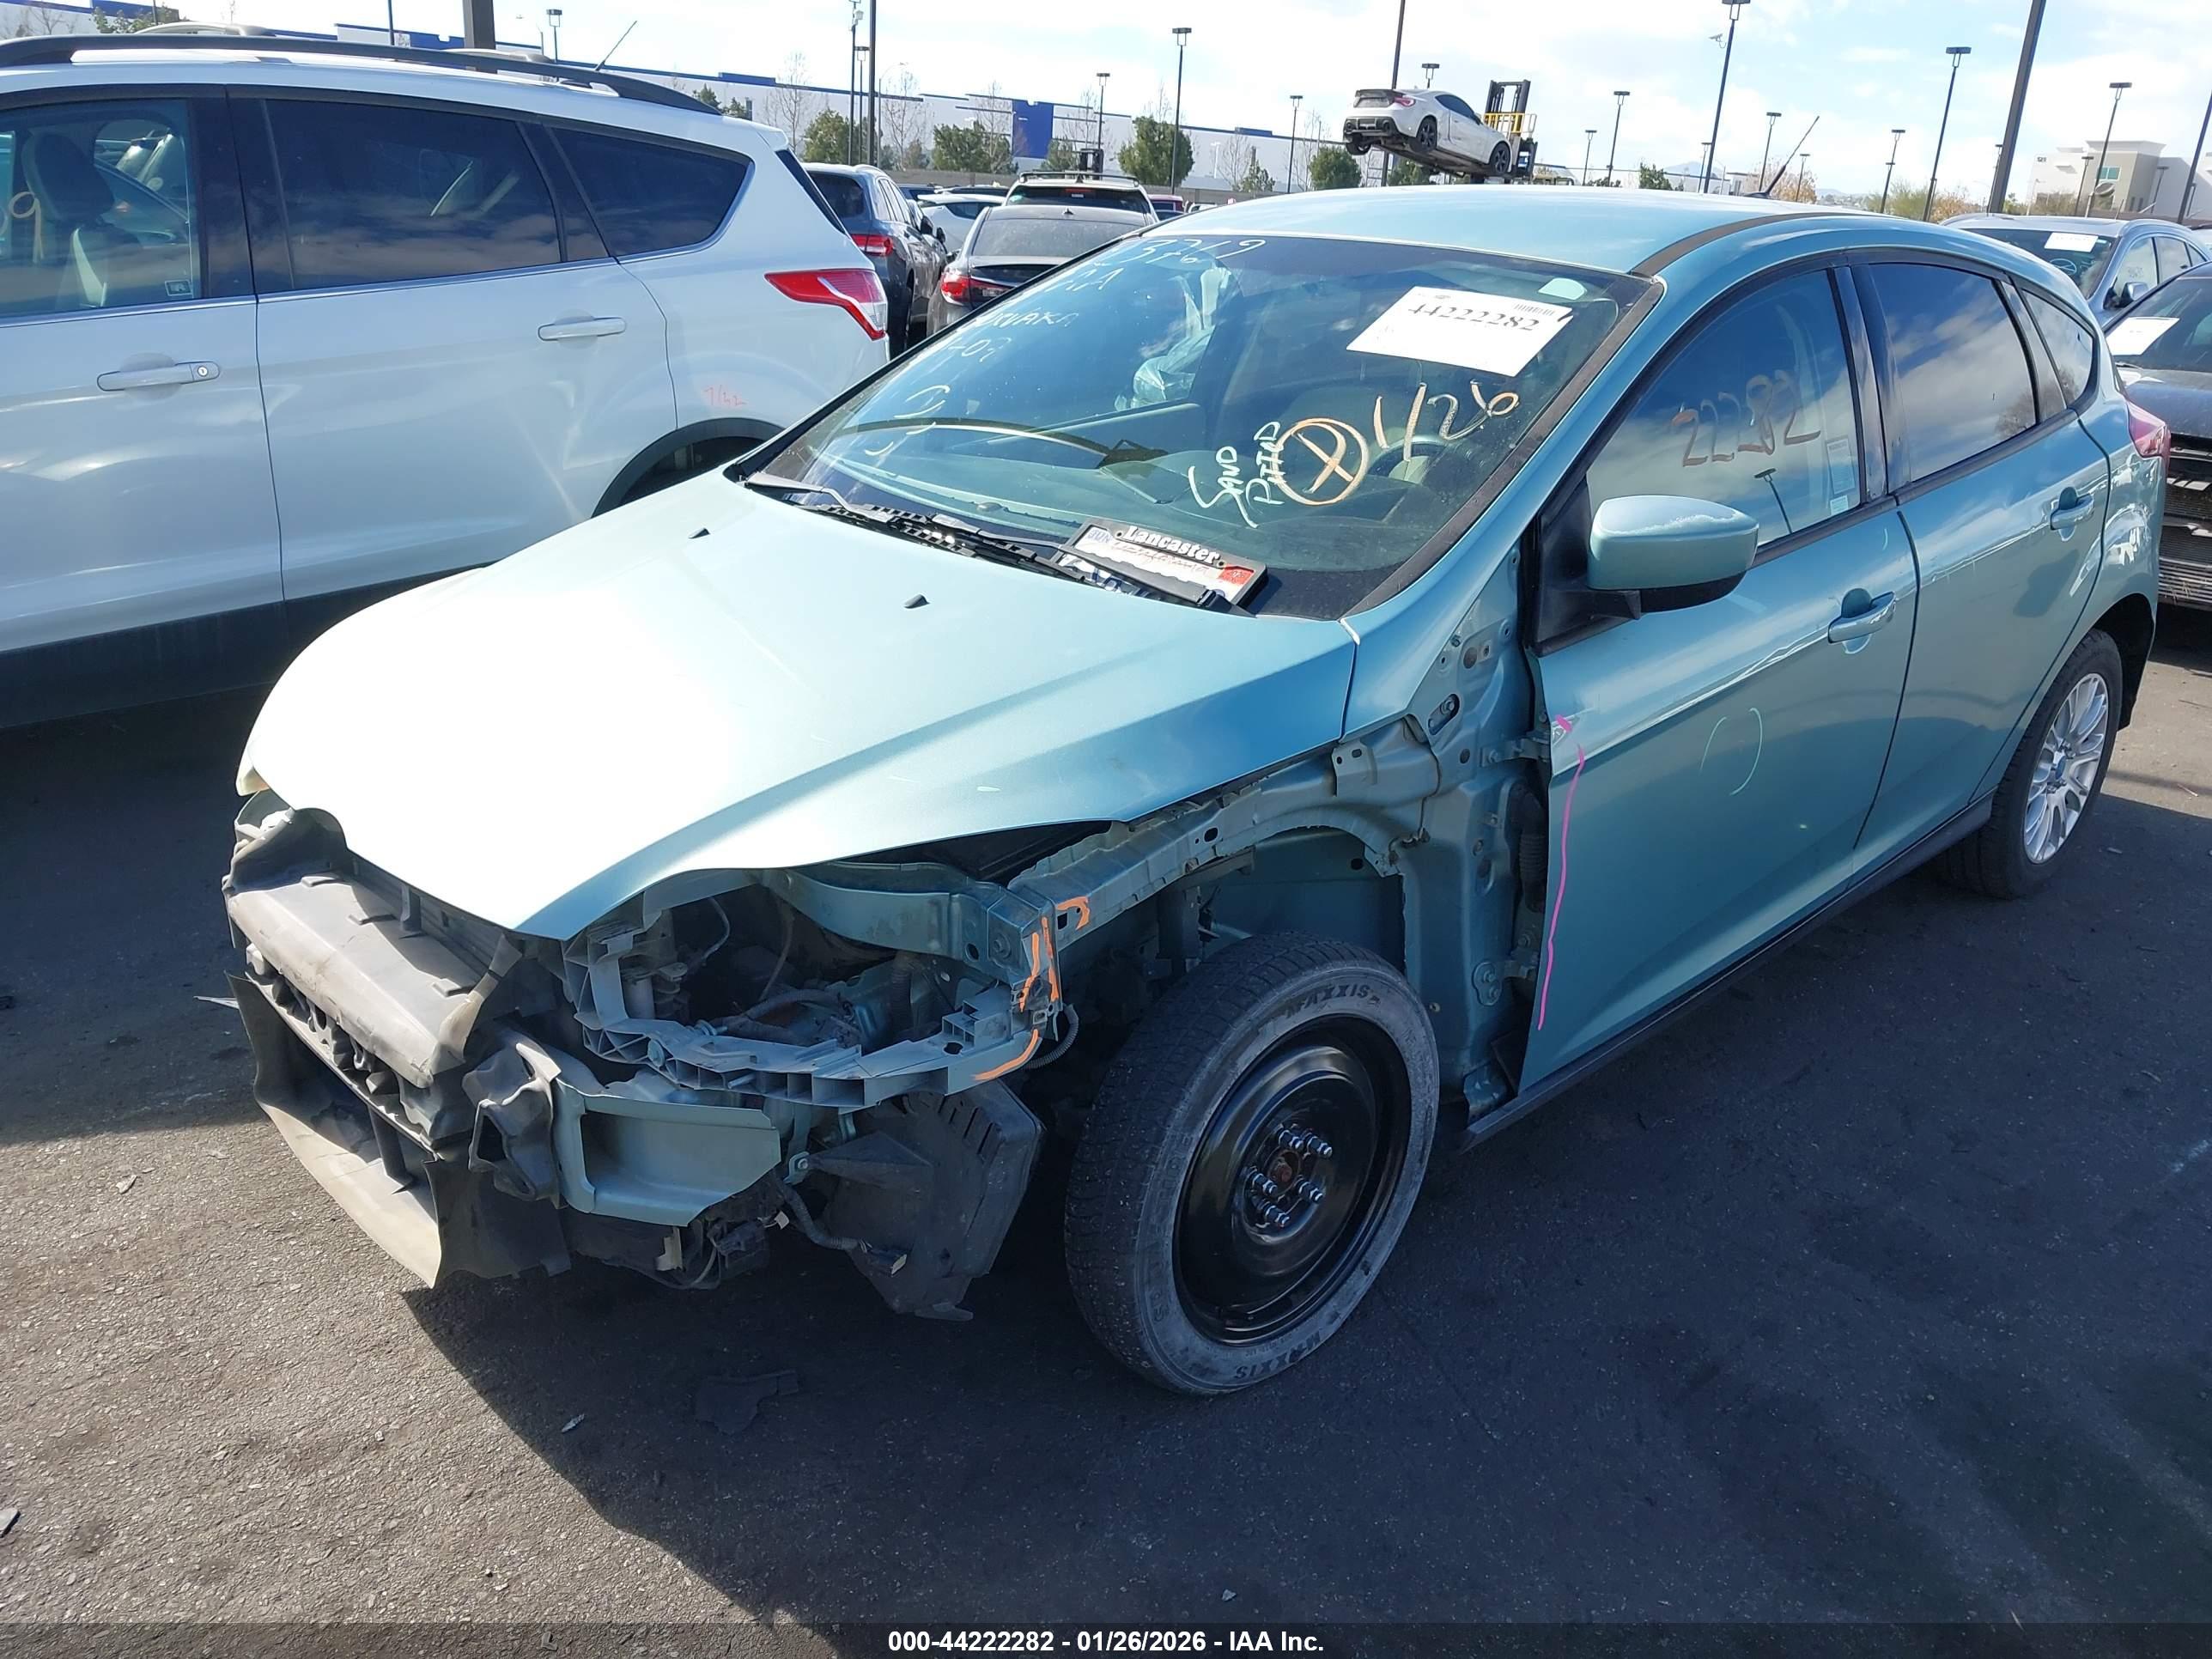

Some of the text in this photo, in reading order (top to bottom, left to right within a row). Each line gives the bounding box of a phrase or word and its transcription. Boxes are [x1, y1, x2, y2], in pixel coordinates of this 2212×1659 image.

[1407, 302, 1540, 331] 44222282
[1373, 379, 1519, 462] 1/26
[1122, 525, 1222, 565] Lancaster
